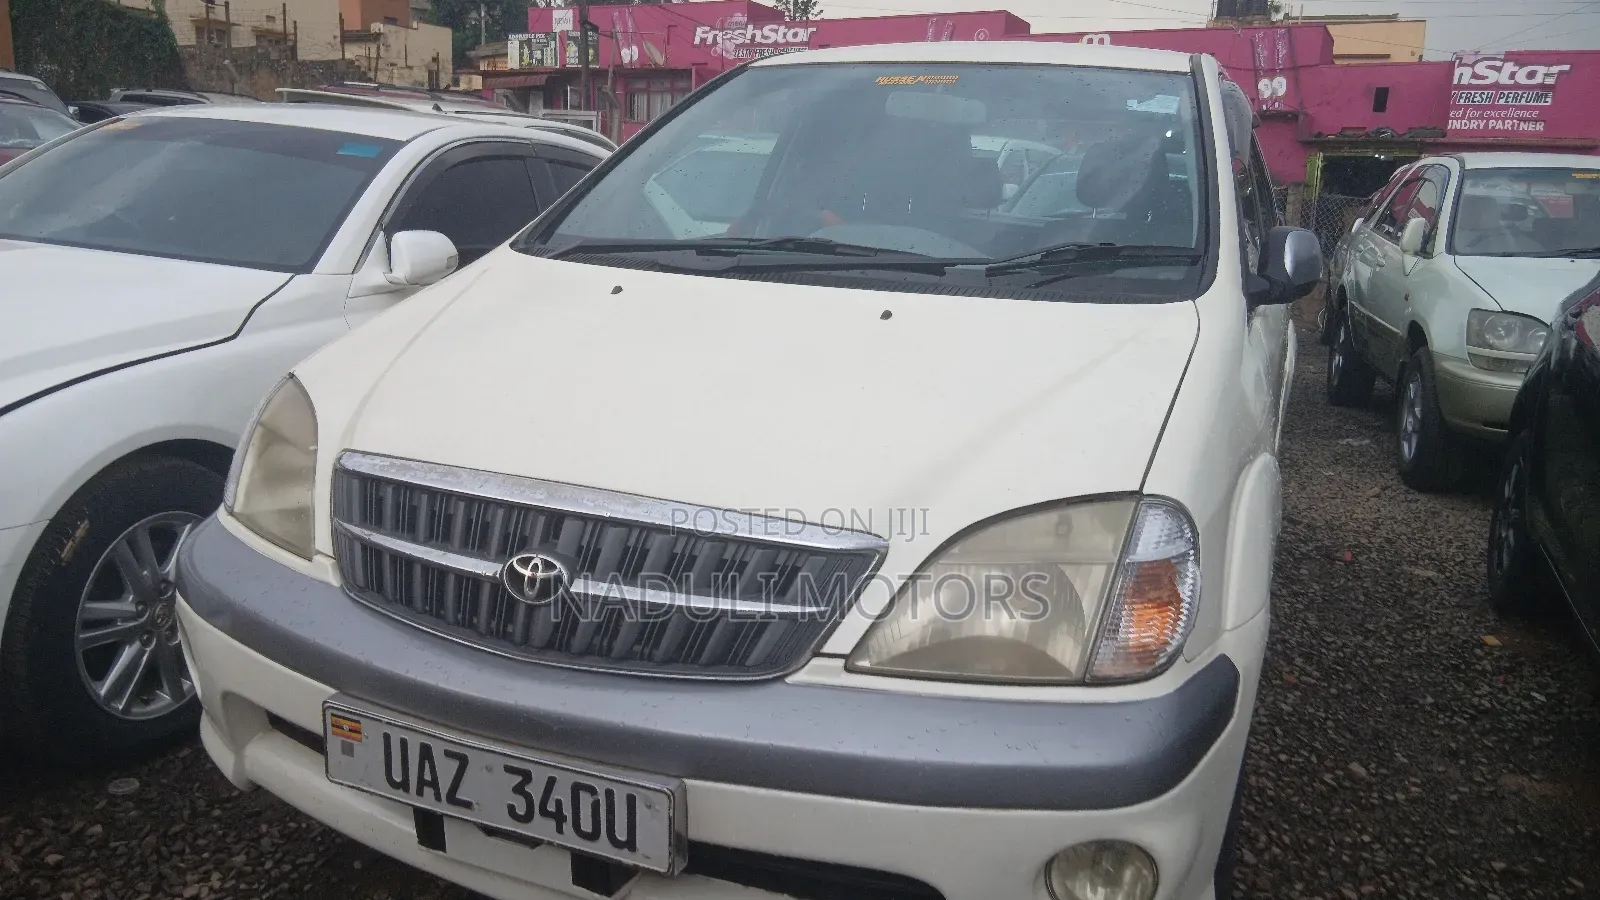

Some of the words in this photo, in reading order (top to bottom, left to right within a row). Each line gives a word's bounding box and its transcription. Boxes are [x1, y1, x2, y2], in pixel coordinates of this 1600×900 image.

[694, 24, 817, 45] FreshStar
[1457, 91, 1494, 104] FRESH
[1497, 91, 1551, 104] PERFUME
[1465, 107, 1483, 120] for
[1483, 107, 1540, 118] excellence
[1488, 119, 1545, 131] PARTNER
[382, 731, 474, 810] UAZ
[503, 764, 638, 853] 340U
